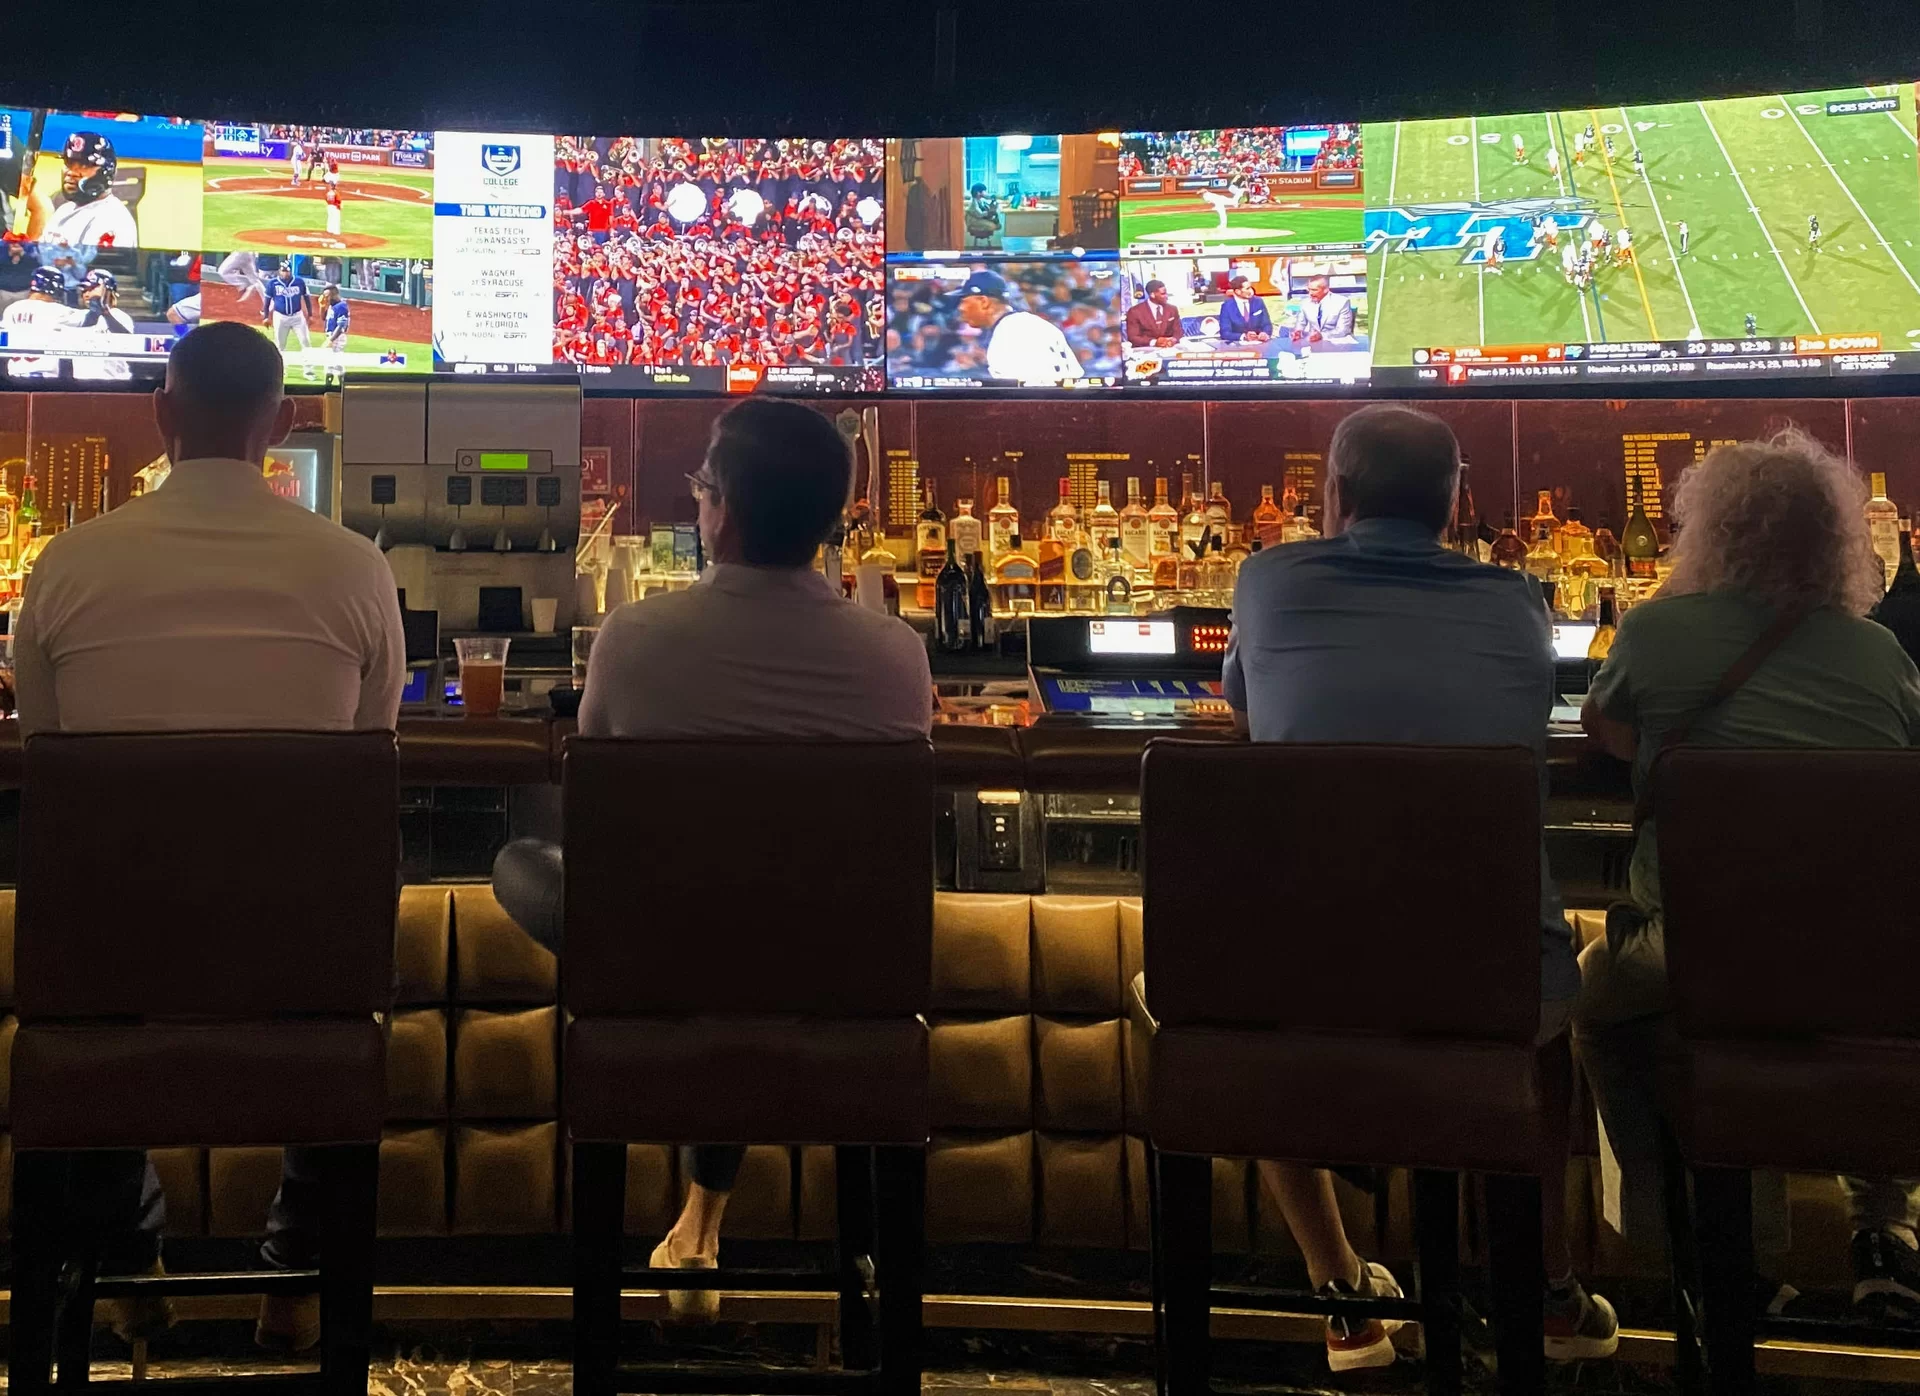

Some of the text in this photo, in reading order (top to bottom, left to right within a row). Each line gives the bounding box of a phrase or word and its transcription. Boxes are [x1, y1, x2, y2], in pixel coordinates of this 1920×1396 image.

[1858, 100, 1897, 111] SPORTS
[362, 153, 381, 161] PARK
[483, 178, 519, 186] COLLEGE
[1279, 176, 1312, 185] STADIUM
[474, 227, 524, 235] TEXAS TECH
[481, 269, 515, 277] WAGNER
[481, 279, 524, 287] SYRACUSE
[475, 311, 528, 319] WASHINGTON
[1828, 337, 1877, 349] DOWN
[1590, 343, 1629, 353] MIDDLE
[1688, 343, 1706, 354] 20
